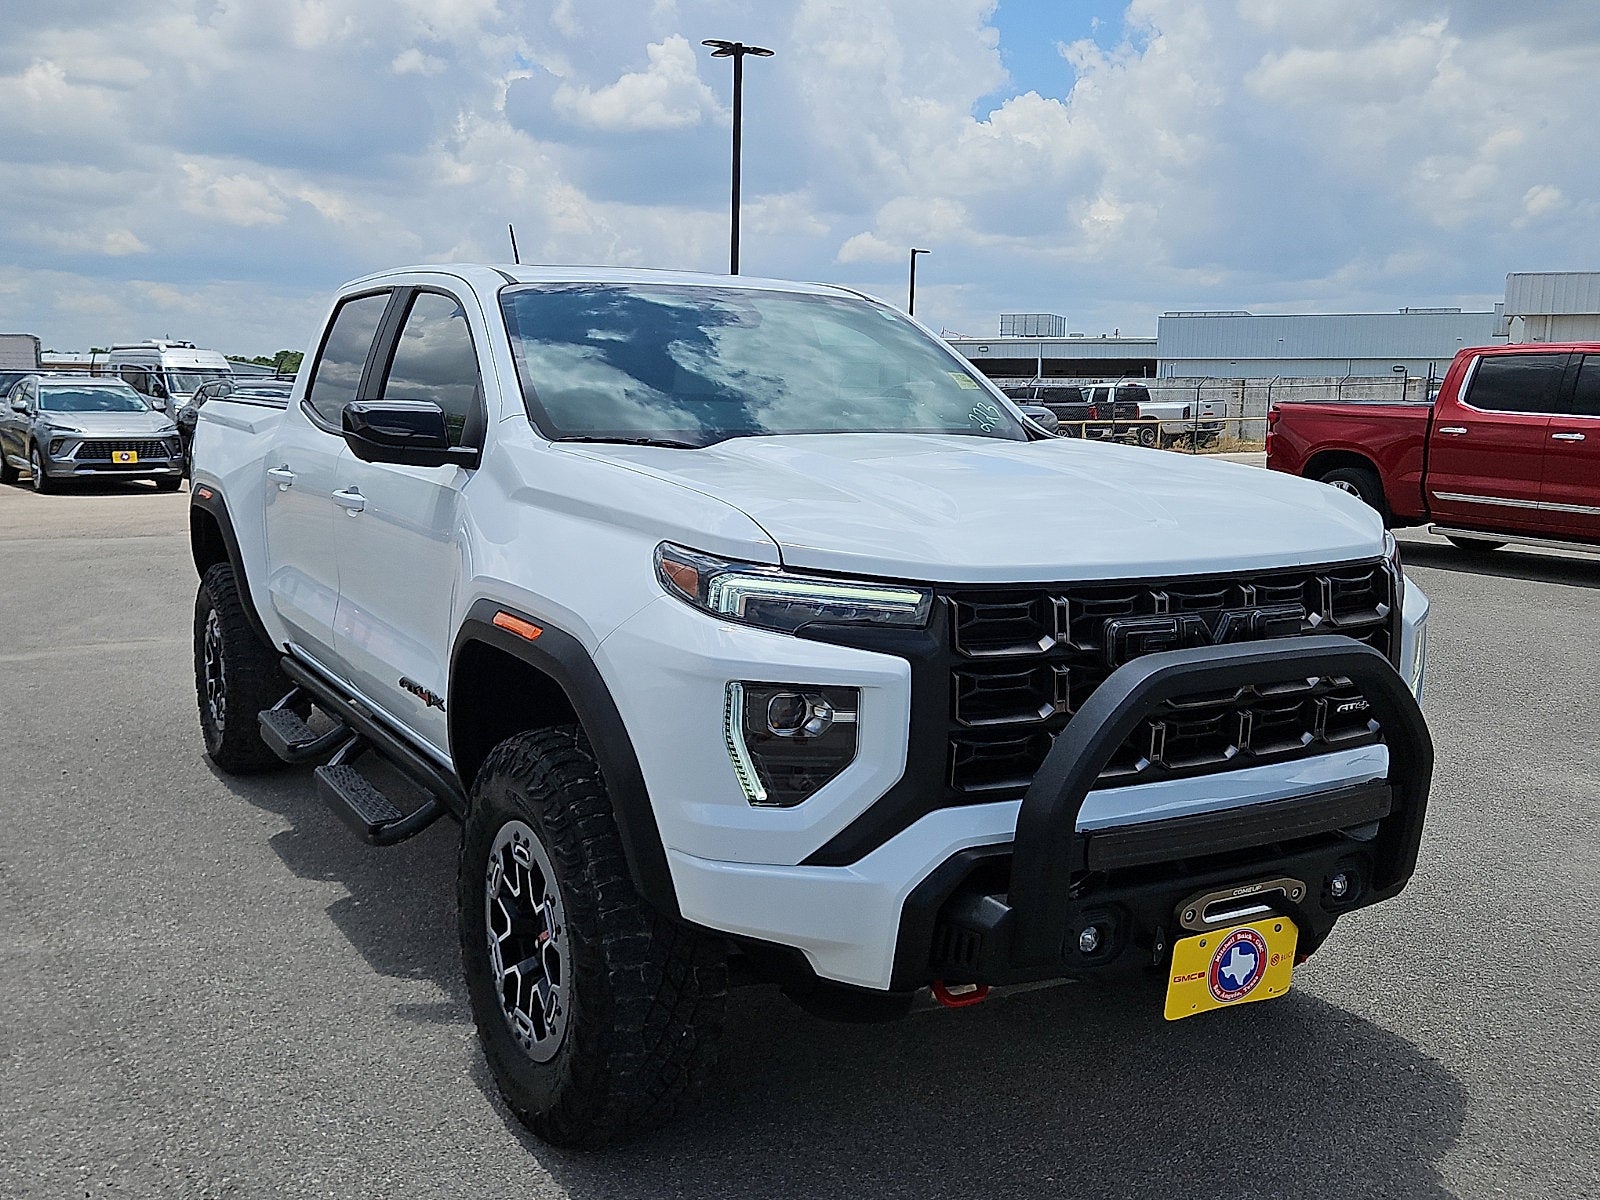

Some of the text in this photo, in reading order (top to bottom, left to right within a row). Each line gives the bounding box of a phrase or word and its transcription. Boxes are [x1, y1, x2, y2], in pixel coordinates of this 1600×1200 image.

[1232, 885, 1262, 896] COMEUP
[1236, 932, 1253, 940] Buick
[1173, 973, 1199, 983] GMC
